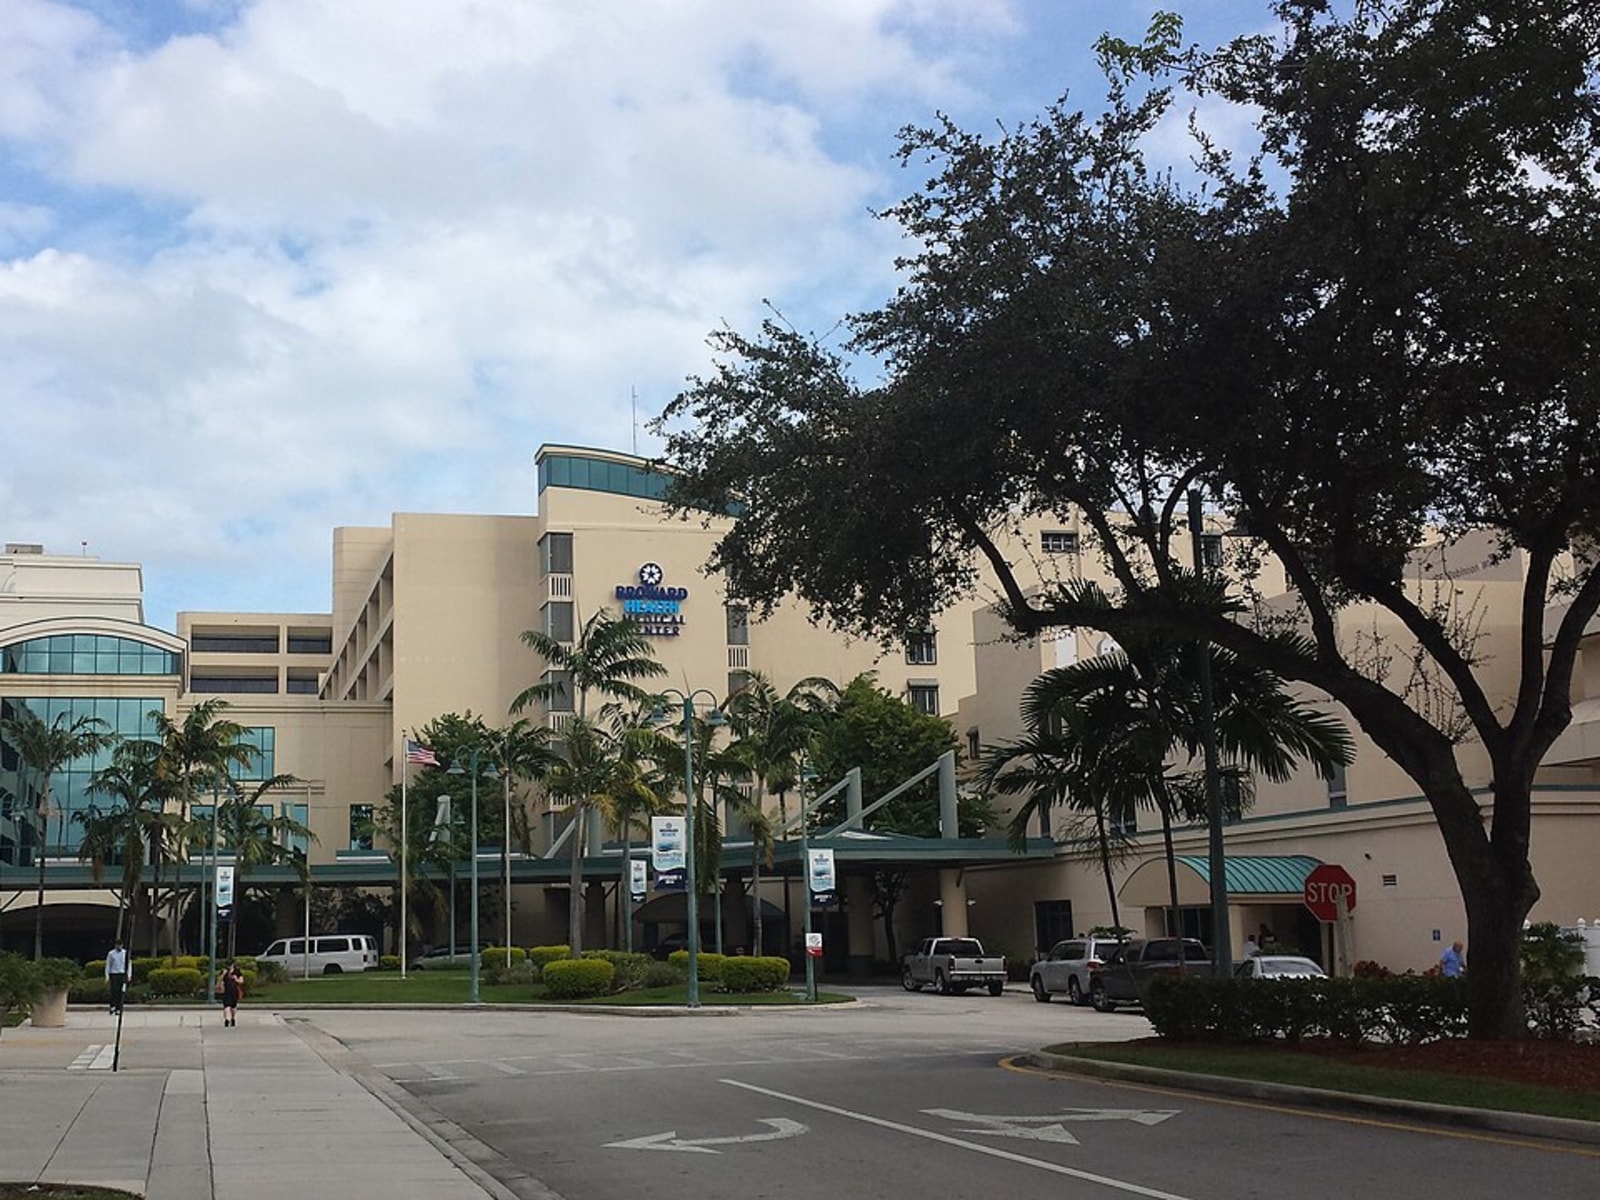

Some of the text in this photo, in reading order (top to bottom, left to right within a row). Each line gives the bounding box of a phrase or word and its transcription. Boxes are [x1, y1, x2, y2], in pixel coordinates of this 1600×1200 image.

[615, 585, 689, 601] BROWARD
[624, 599, 680, 614] HEALTH
[629, 625, 681, 637] ENTER
[1307, 882, 1353, 904] STOP
